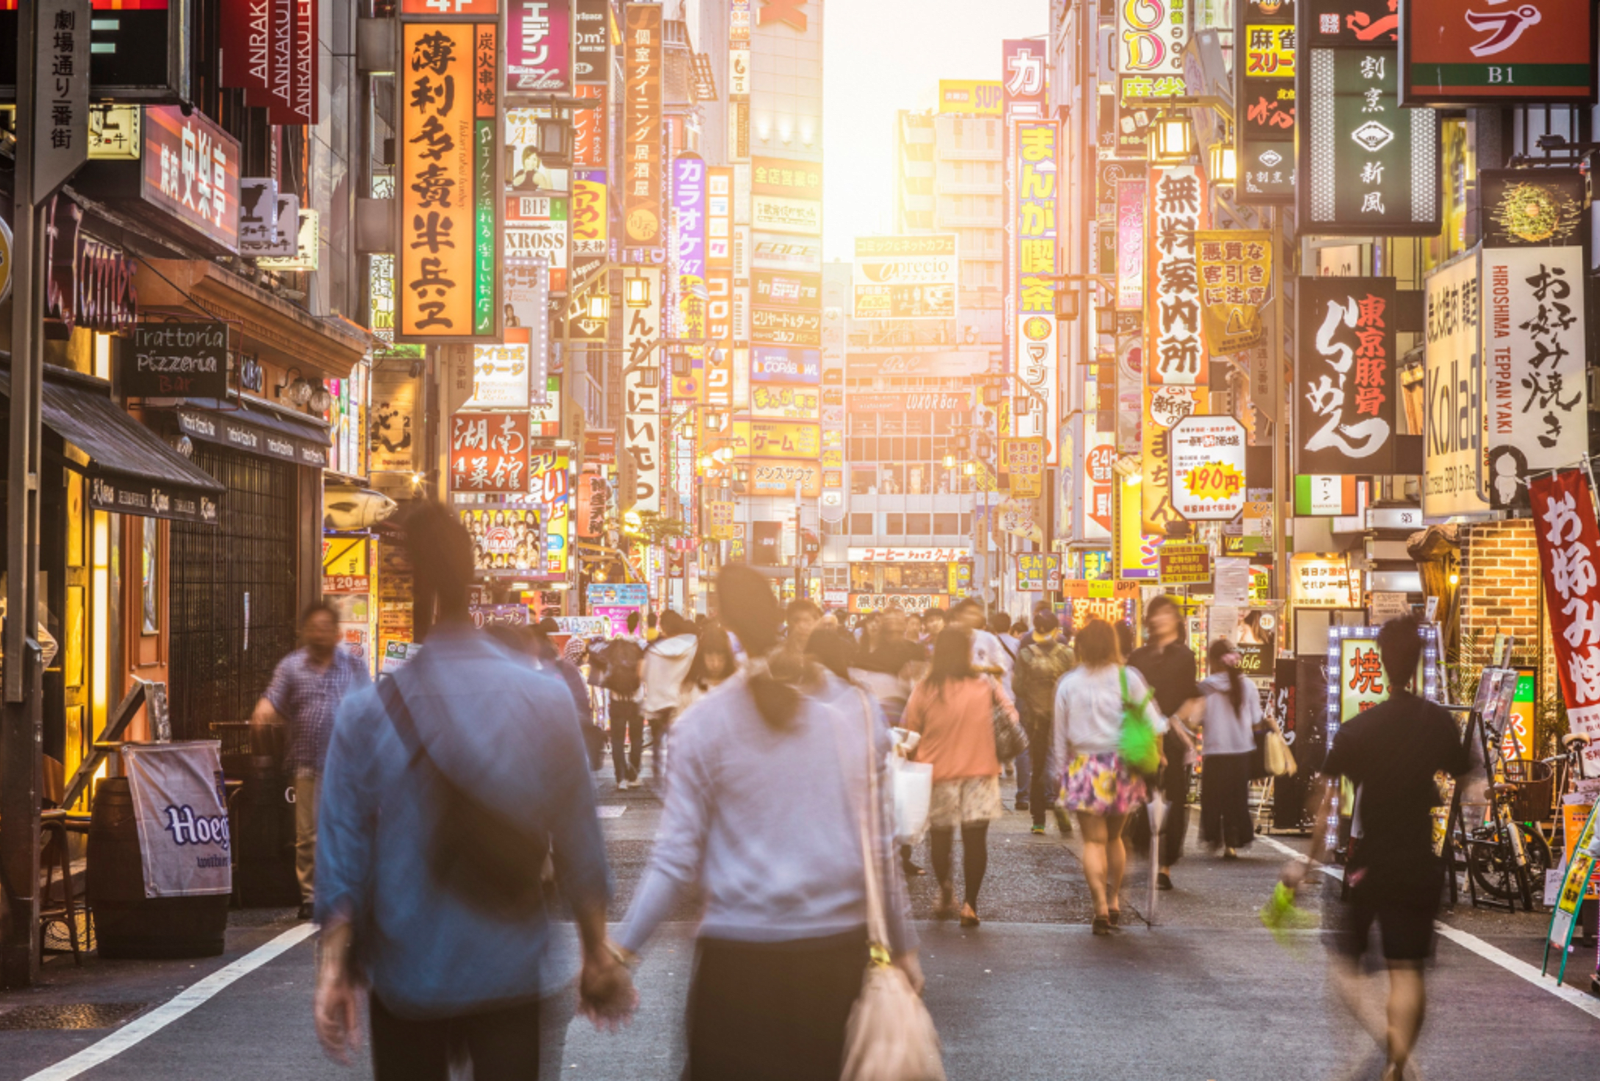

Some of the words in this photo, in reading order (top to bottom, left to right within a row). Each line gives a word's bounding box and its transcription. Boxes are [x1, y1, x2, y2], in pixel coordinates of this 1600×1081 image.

[51, 9, 75, 149] 劇場通り一番街
[477, 33, 495, 105] 炭火串焼
[1249, 53, 1296, 72] スリー
[1487, 66, 1515, 84] B1
[634, 29, 650, 196] 個室ダイニング居酒屋
[678, 159, 701, 255] カラオケ
[754, 166, 819, 189] 全店営業中
[1360, 161, 1386, 215] 新風
[1021, 127, 1056, 311] まんが喫茶
[1158, 174, 1200, 374] 無料案内所
[1204, 264, 1265, 284] 客引き
[1493, 265, 1510, 338] HIROSHIMA
[1355, 294, 1386, 416] 東京豚骨
[1518, 263, 1582, 448] お好み焼き
[753, 433, 795, 452] ゲーム
